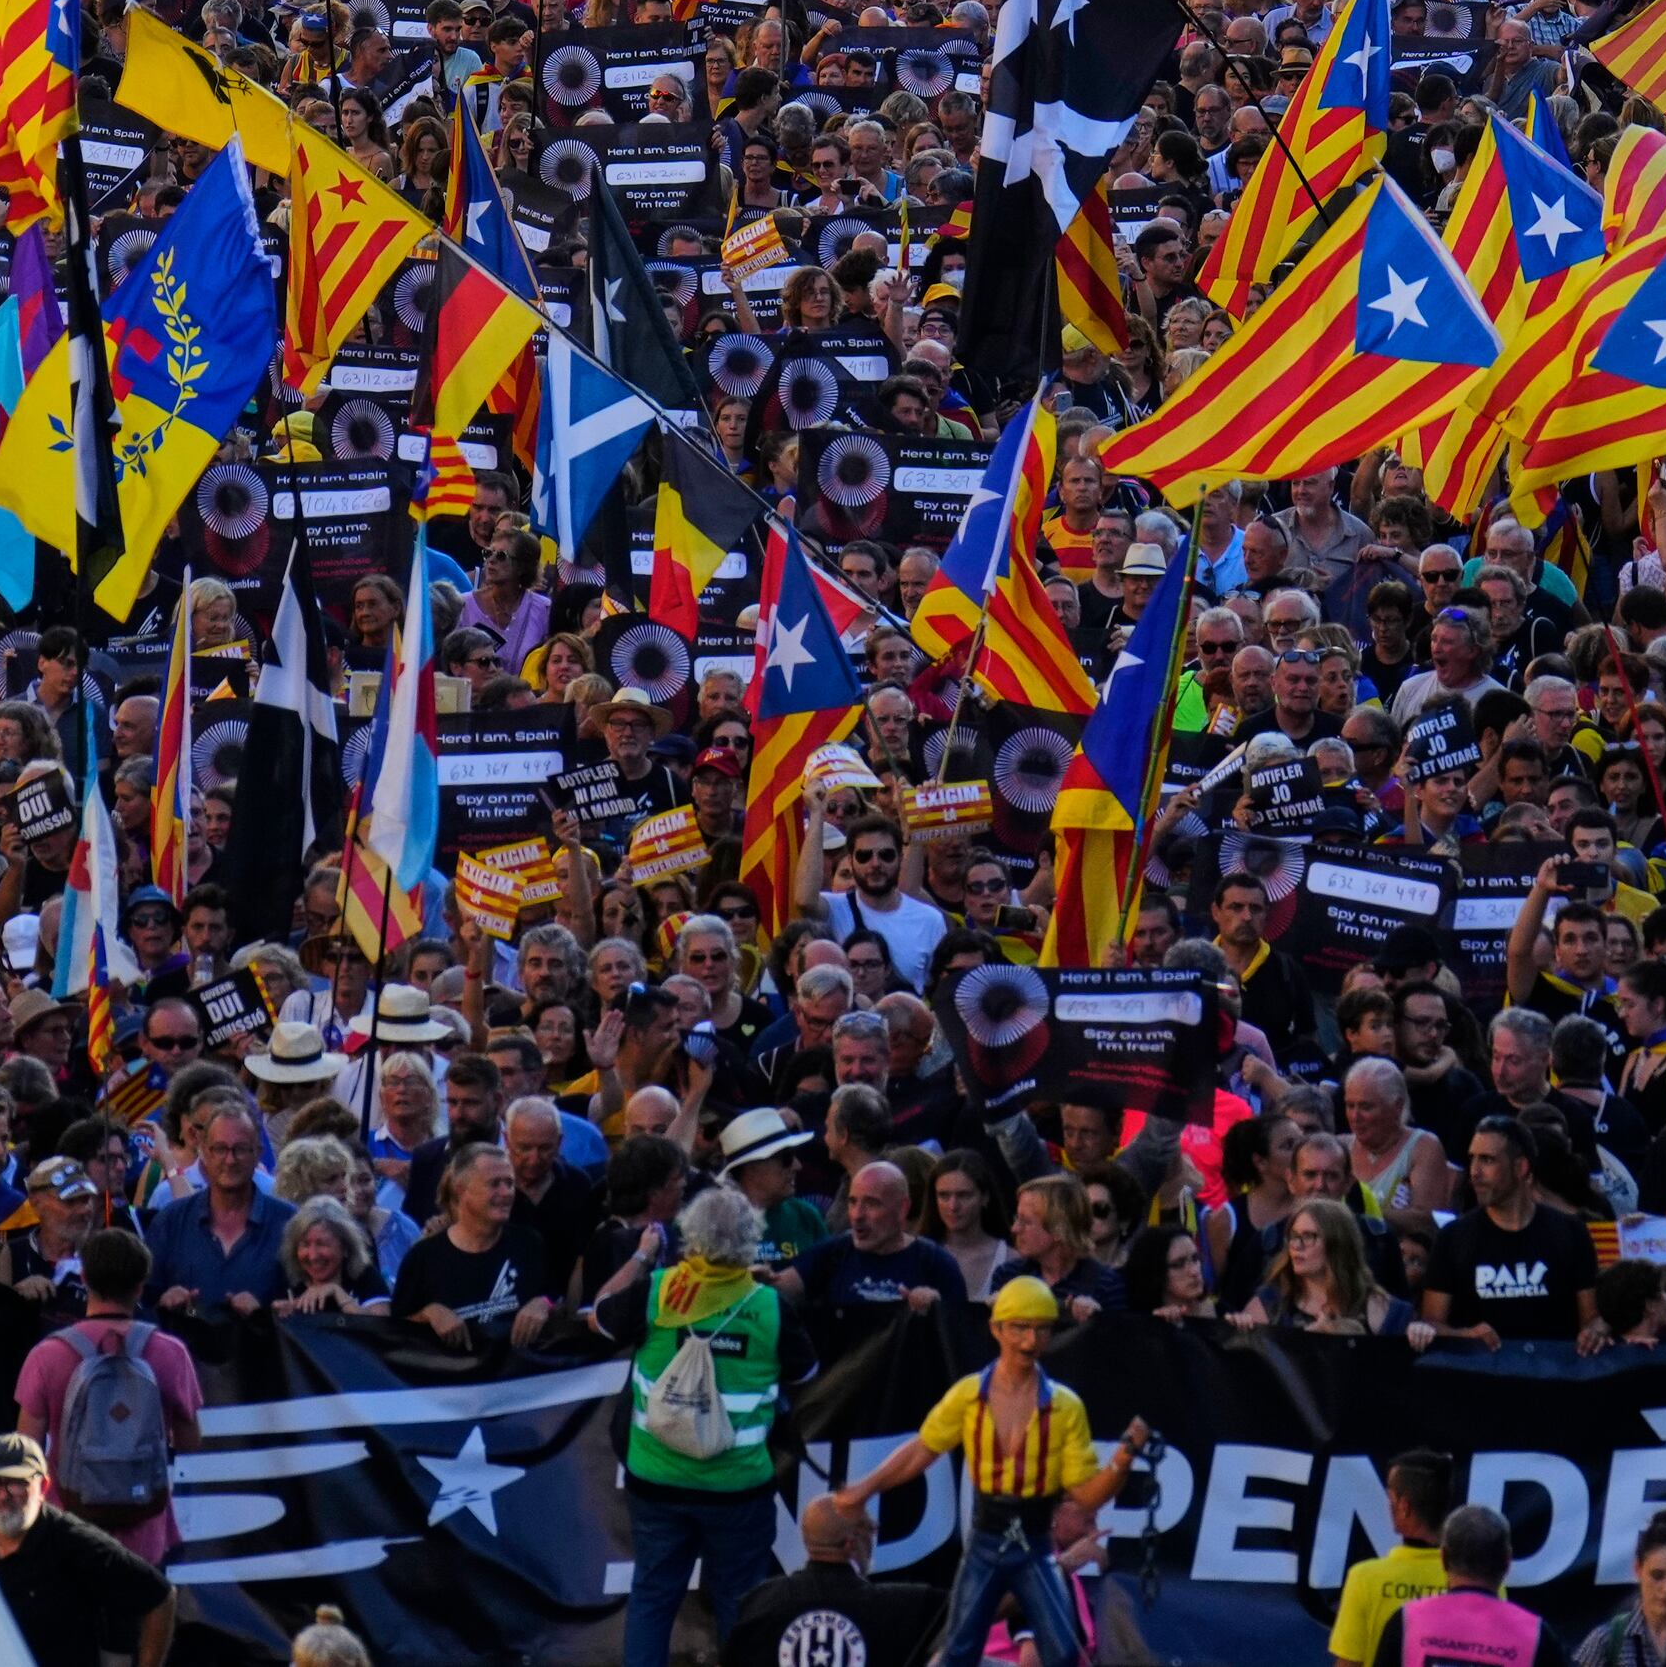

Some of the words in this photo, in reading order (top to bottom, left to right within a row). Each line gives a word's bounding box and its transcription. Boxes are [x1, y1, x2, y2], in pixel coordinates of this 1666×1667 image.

[607, 147, 635, 156] Here
[638, 147, 642, 155] I
[667, 144, 701, 154] Spain
[626, 191, 647, 200] Spy
[635, 200, 653, 208] I'm
[656, 199, 680, 208] free!
[726, 221, 769, 253] EXIGIM
[475, 731, 479, 742] I
[515, 730, 560, 742] Spain
[1408, 713, 1457, 743] BOTIFLER
[1427, 736, 1447, 757] JO
[1422, 759, 1436, 775] ET
[1437, 745, 1480, 773] VOTARÉ
[556, 762, 620, 790] BOTIFLERS
[1250, 763, 1304, 789] BOTIFLER
[456, 794, 485, 806] Spy
[488, 794, 507, 804] on
[574, 789, 588, 804] NI
[590, 779, 619, 801] AQUÍ
[915, 784, 981, 808] EXIGIM
[1271, 788, 1291, 806] JO
[18, 794, 53, 823] DUI
[468, 808, 491, 819] I'm
[494, 807, 527, 818] free!
[593, 797, 636, 818] MADRID
[943, 808, 958, 823] LA
[1264, 809, 1280, 823] ET
[1281, 797, 1326, 821] VOTARÉ
[637, 811, 686, 843] EXIGIM
[654, 838, 669, 854] LA
[461, 859, 515, 896] EXIGIM
[1399, 856, 1443, 875] Spain
[206, 991, 245, 1025] DUI
[214, 1010, 266, 1042] DIMISSIÓ
